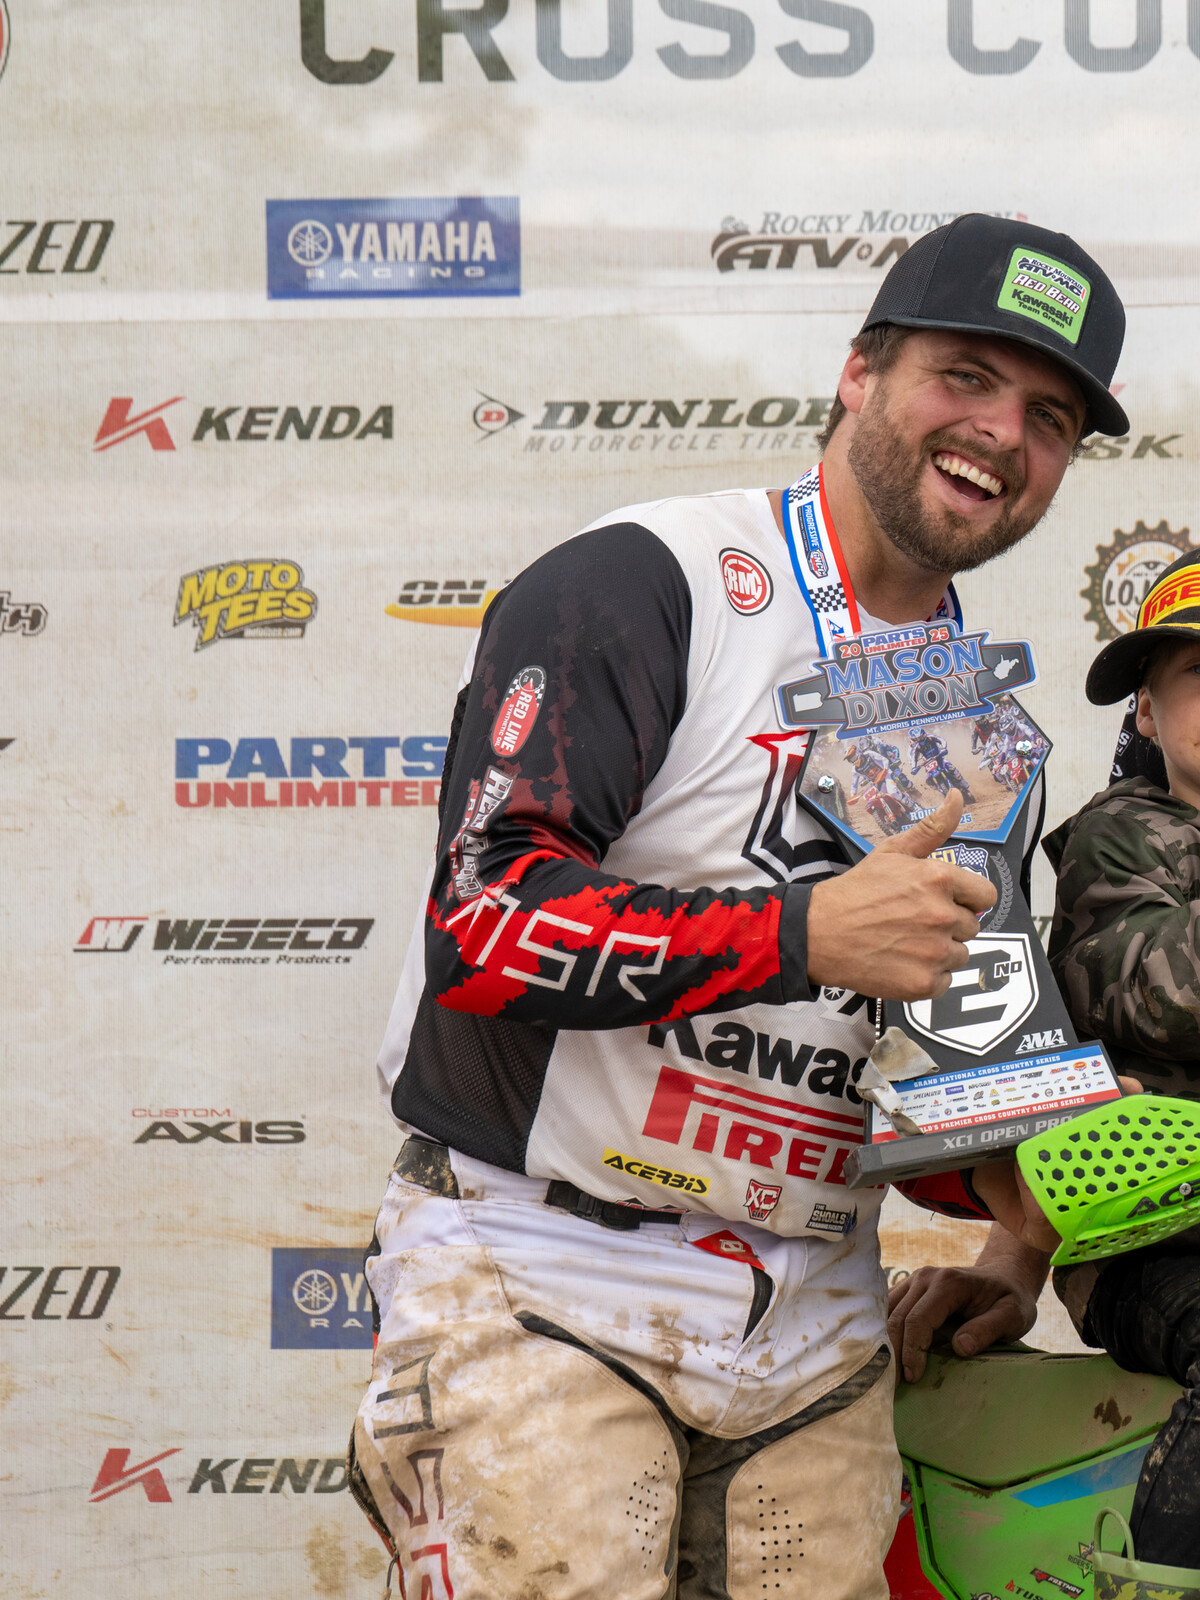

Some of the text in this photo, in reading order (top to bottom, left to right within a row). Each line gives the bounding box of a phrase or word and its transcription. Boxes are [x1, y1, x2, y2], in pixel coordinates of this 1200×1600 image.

[760, 211, 847, 235] ROCKY
[336, 221, 497, 262] YAMAHA
[305, 266, 486, 279] RACING
[1031, 259, 1083, 290] ROCKY MOUNTAIN
[1011, 288, 1074, 327] Kawasaki
[1012, 273, 1080, 314] RED BEAR
[1018, 301, 1065, 329] Team Green
[192, 404, 395, 442] KENDA
[523, 432, 719, 453] MOTORCYCLE
[804, 504, 820, 548] PROGRESSIVE
[178, 562, 300, 619] MOTO
[200, 589, 315, 644] TEES
[840, 627, 950, 659] 20 25
[862, 628, 926, 648] PARTS
[864, 637, 926, 654] UNLIMITED
[824, 637, 985, 696] MASON
[843, 674, 982, 729] DIXON
[497, 703, 515, 737] SYNTHETIC
[500, 690, 533, 753] RED LINE
[866, 711, 966, 735] MT. MORRIS PENNSYLVANIA
[174, 737, 449, 779] PARTS
[152, 917, 375, 951] WISECO
[163, 953, 352, 967] Performance Products
[1015, 1028, 1068, 1053] AMA
[913, 1054, 1061, 1088] GRAND NATIONAL CROSS COUNTRY SERIES
[131, 1107, 231, 1119] CUSTOM
[940, 1096, 1085, 1130] PREMIER CROSS COUNTRY RACING SERIES
[132, 1120, 307, 1145] AXIS
[943, 1133, 973, 1151] XC1
[980, 1123, 1029, 1143] OPEN
[603, 1154, 708, 1195] ACERBIS
[811, 1209, 847, 1225] SHOALS
